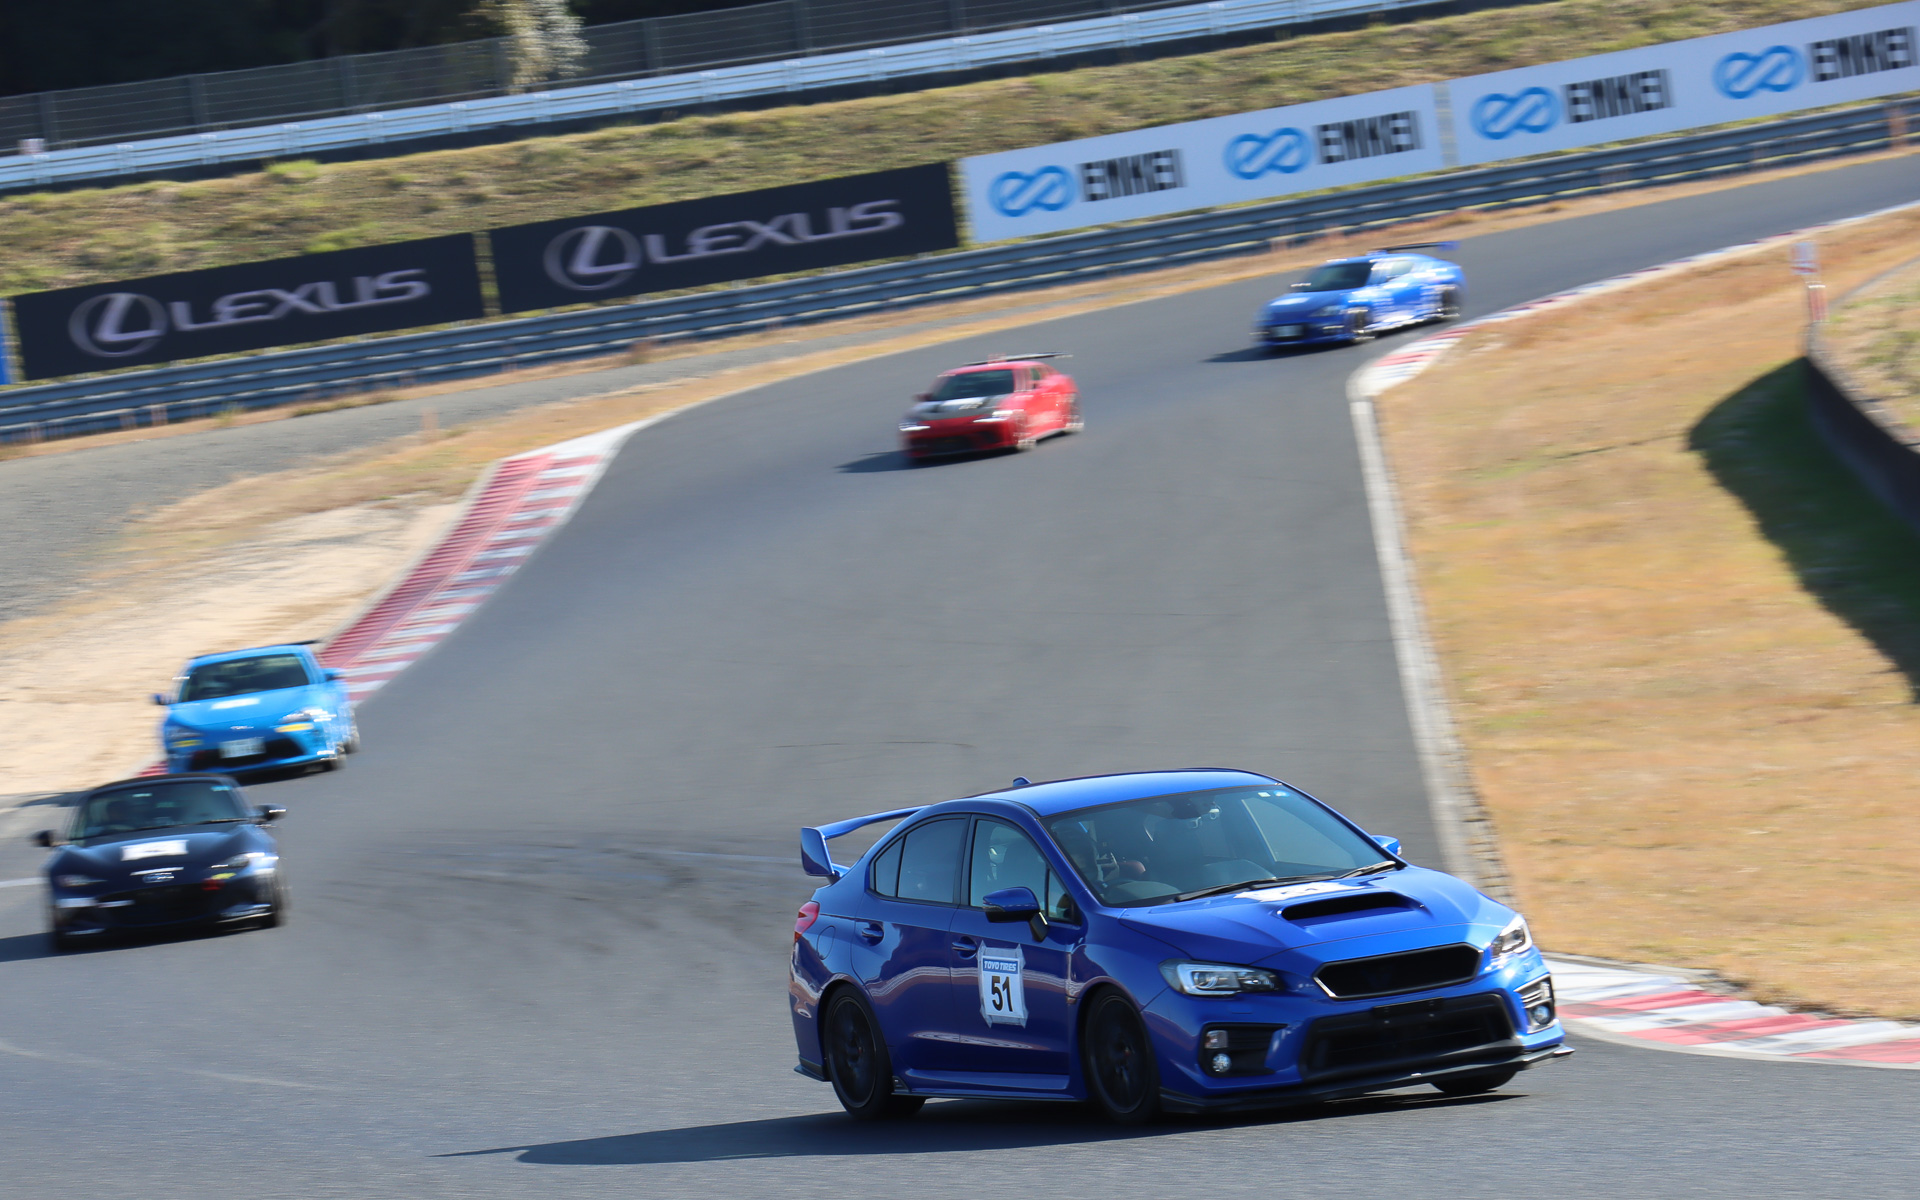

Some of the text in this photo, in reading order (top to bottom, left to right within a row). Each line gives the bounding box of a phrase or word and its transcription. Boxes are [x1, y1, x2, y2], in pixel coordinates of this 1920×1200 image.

[1561, 69, 1673, 124] ENKEI
[1314, 110, 1424, 164] ENKEI
[1077, 148, 1187, 202] ENKEI
[642, 199, 904, 265] LEXUS
[167, 269, 431, 332] LEXUS
[984, 960, 1017, 972] TOYO TIRES
[991, 975, 1013, 1012] 51
